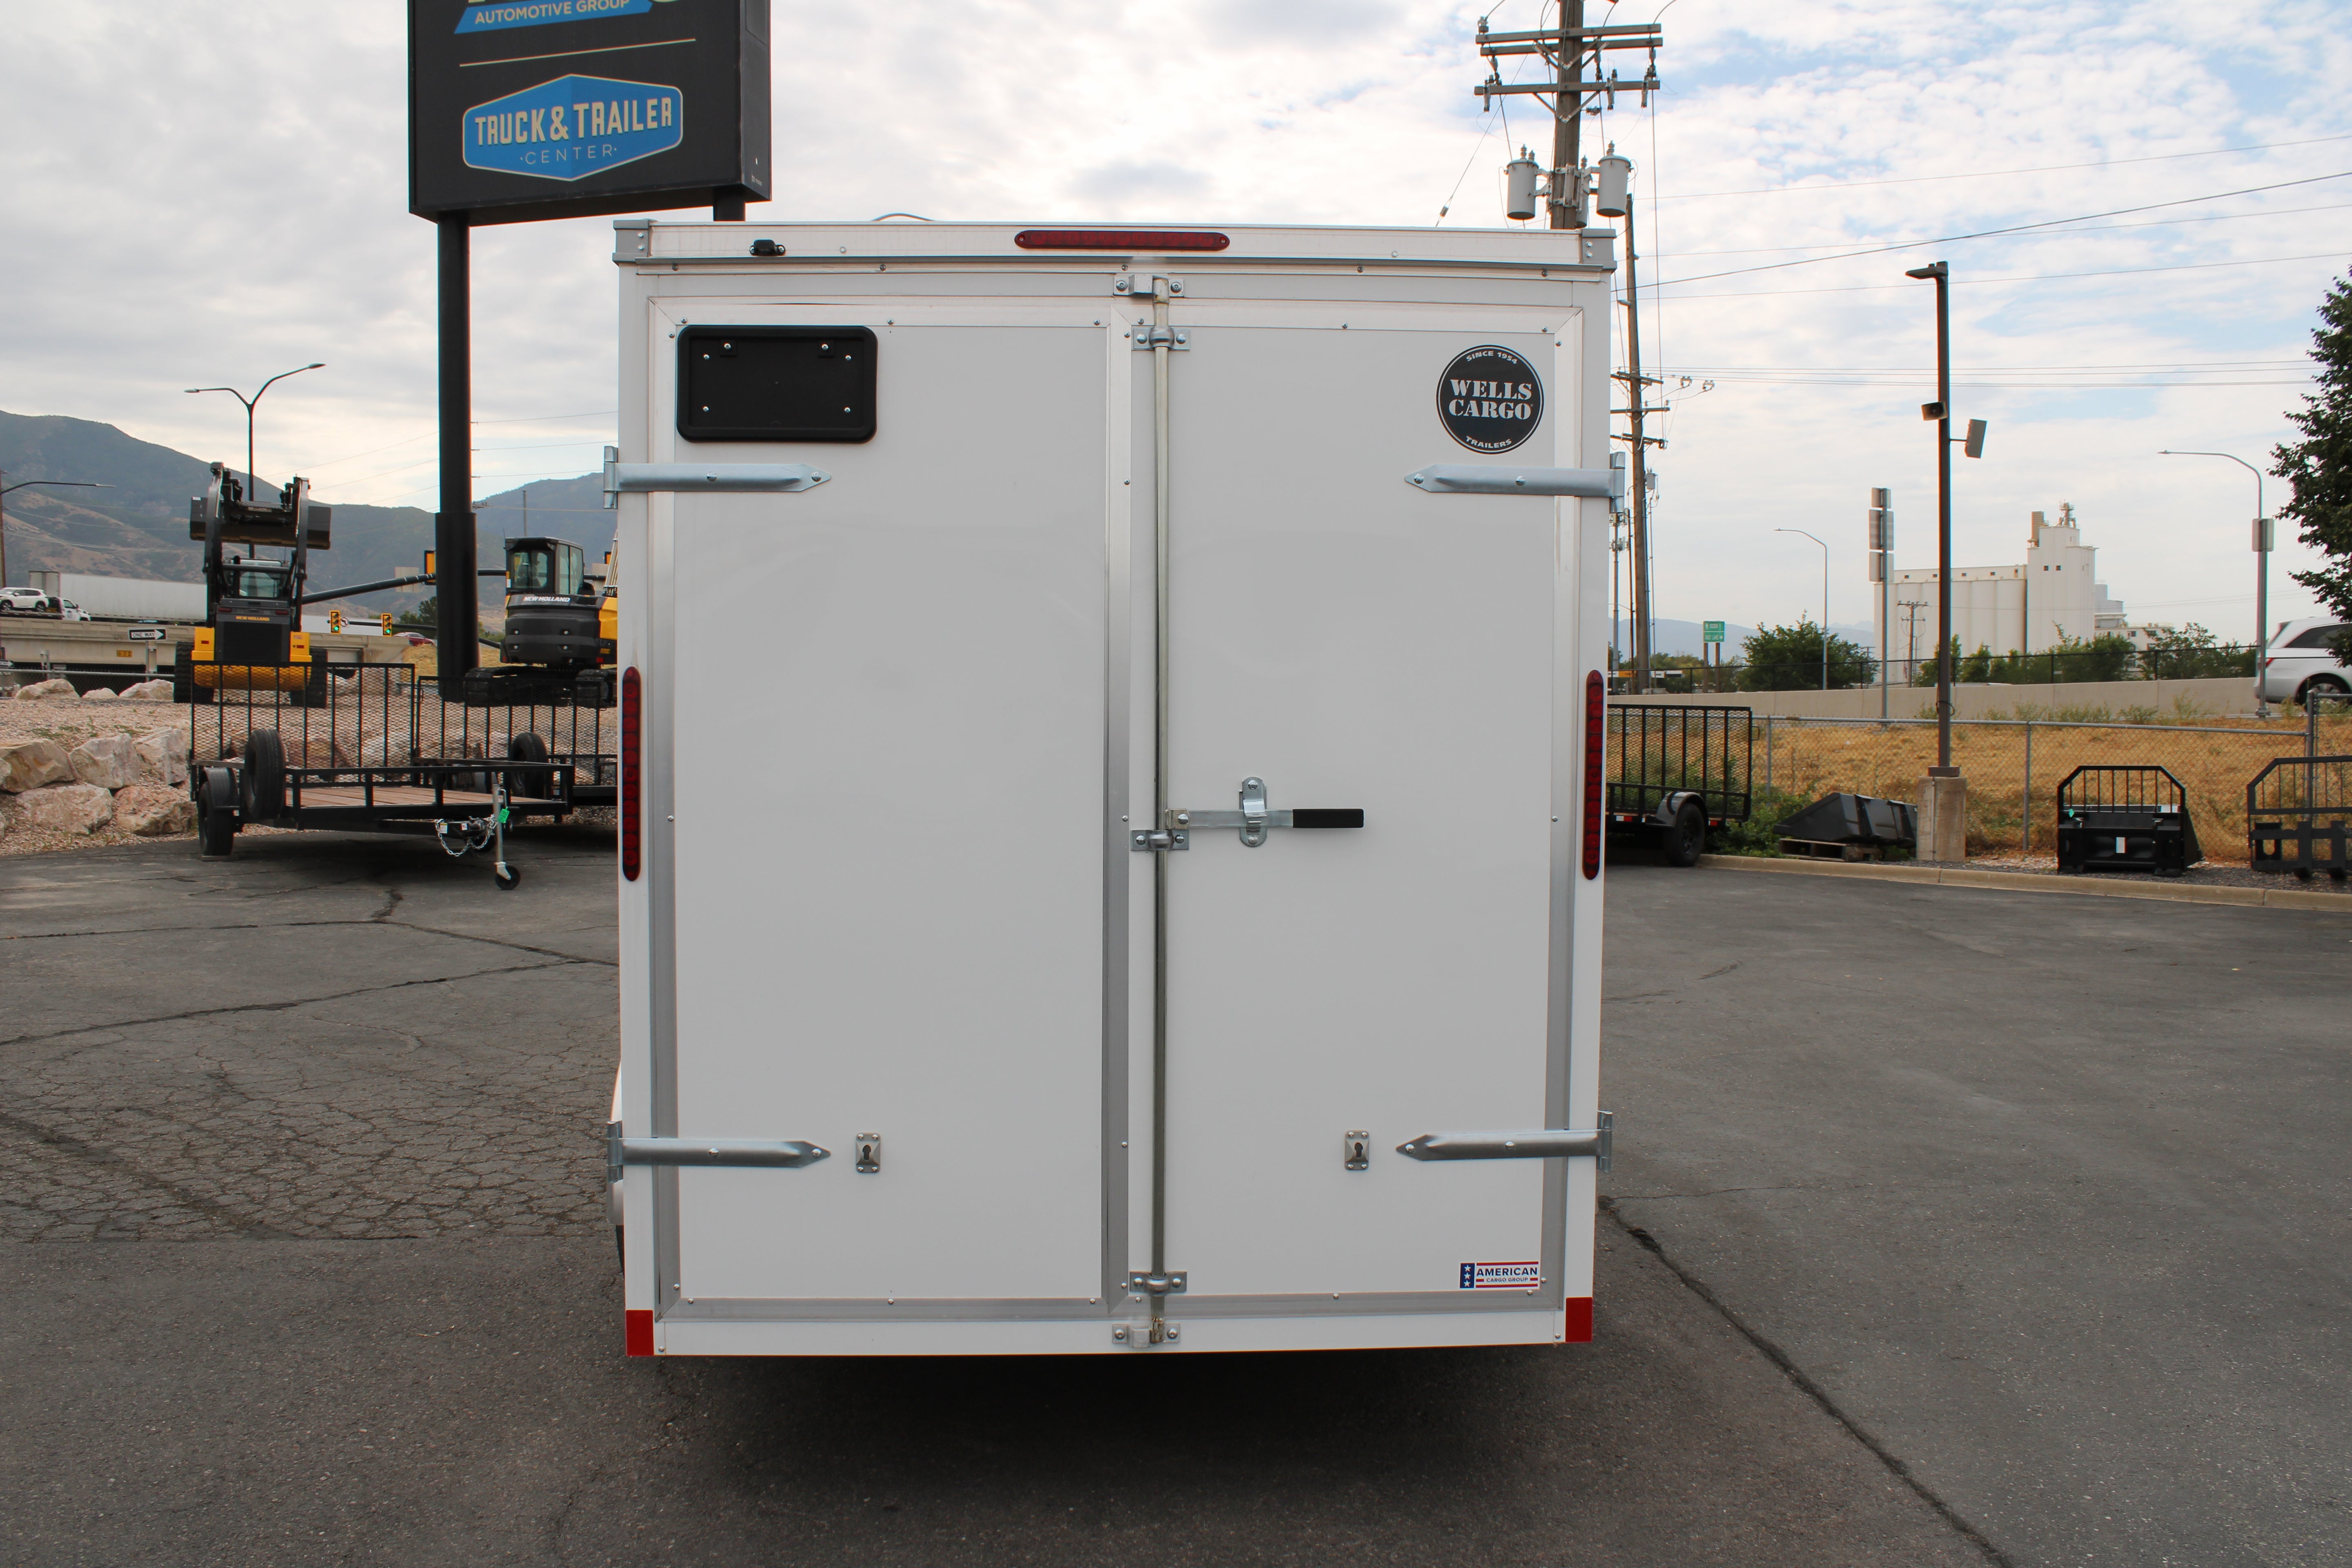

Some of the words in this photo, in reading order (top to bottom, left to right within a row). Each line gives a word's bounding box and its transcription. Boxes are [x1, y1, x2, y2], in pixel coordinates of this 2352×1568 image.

[474, 1, 572, 24] AUTOMOTIVE
[576, 0, 629, 13] GROUP
[475, 108, 546, 146] TRUCK
[550, 105, 569, 141] &
[573, 97, 672, 138] TRAILER
[525, 144, 612, 165] CENTER
[1466, 351, 1494, 361] SINCE
[1497, 352, 1518, 364] 1954
[1450, 379, 1532, 401] WELLS
[1448, 399, 1531, 420] CARGO
[1466, 435, 1512, 448] TRAILERS
[1476, 1267, 1537, 1276] AMERICAN
